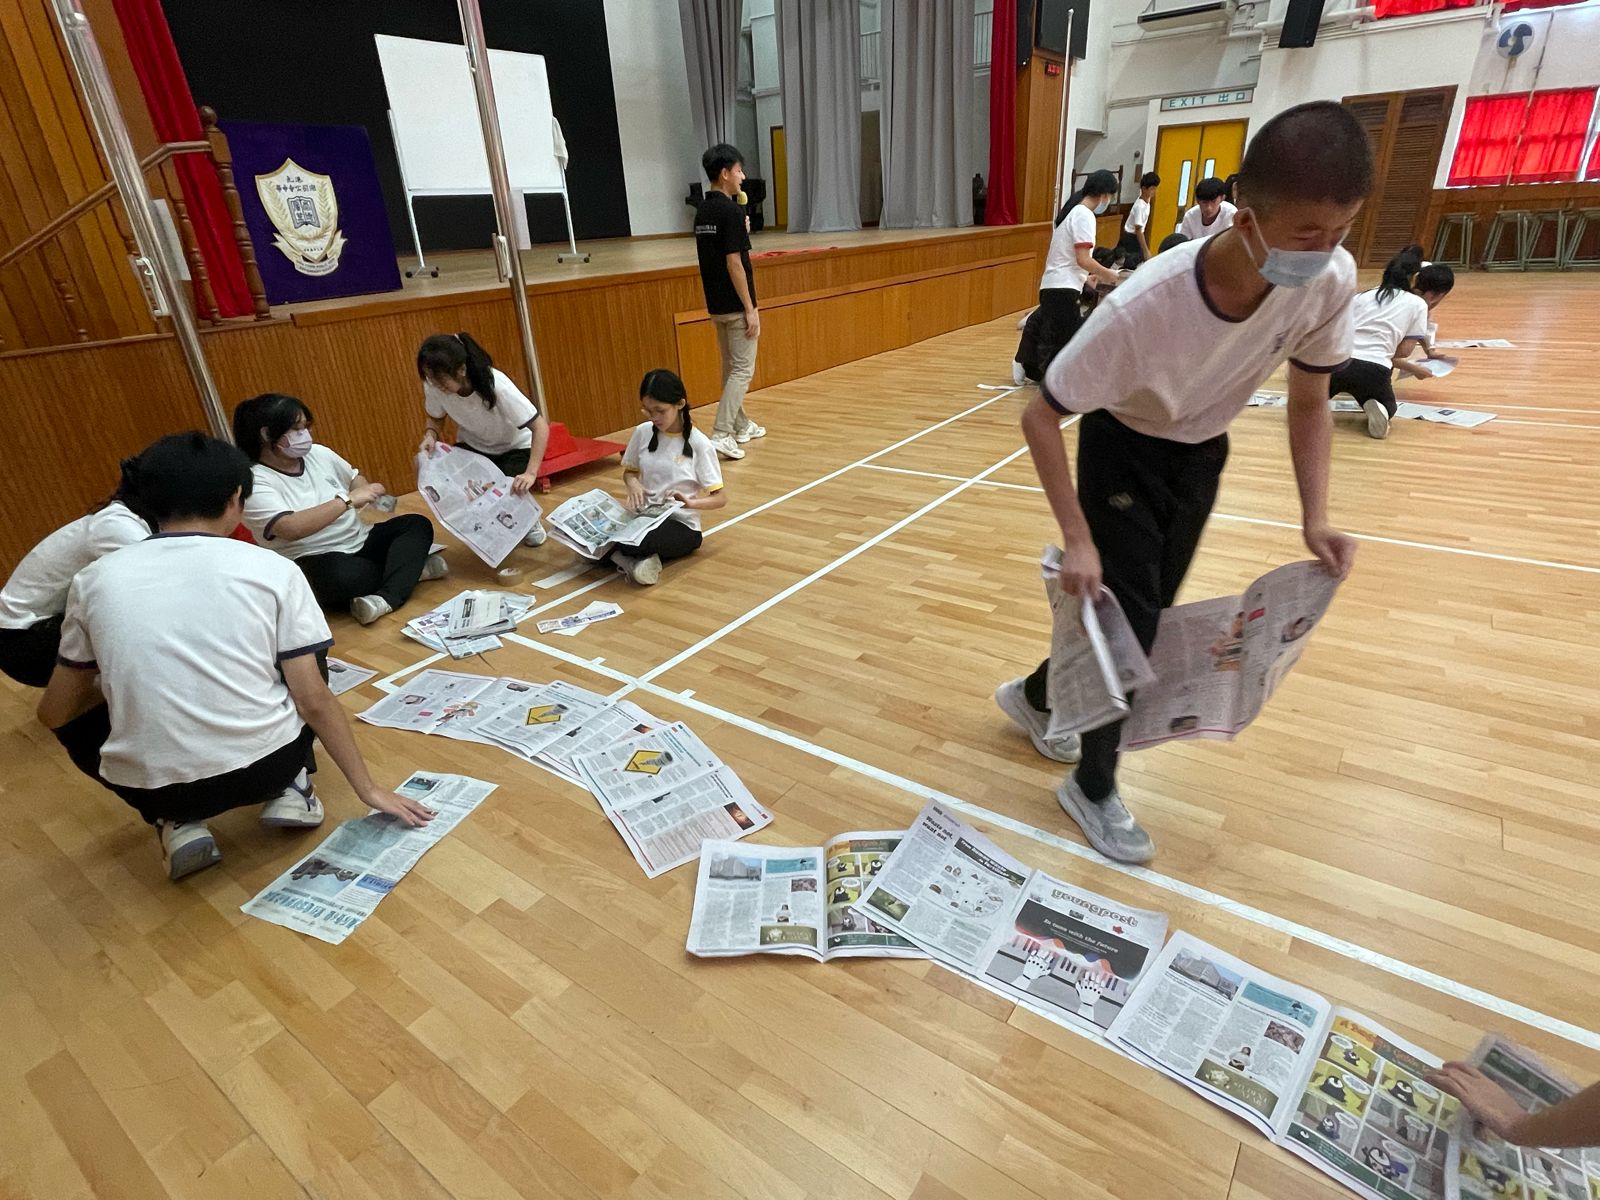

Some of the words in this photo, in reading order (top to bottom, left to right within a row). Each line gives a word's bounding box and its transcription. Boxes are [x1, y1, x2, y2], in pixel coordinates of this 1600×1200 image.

[1169, 96, 1206, 107] EXIT
[1218, 92, 1246, 102] 出口
[922, 821, 937, 834] want
[936, 831, 947, 841] not
[926, 815, 943, 830] Waste
[1051, 888, 1139, 927] youngpost
[1043, 918, 1052, 926] In
[1052, 920, 1067, 932] tune
[1068, 926, 1084, 939] with
[1084, 934, 1096, 944] the
[1095, 939, 1119, 953] future
